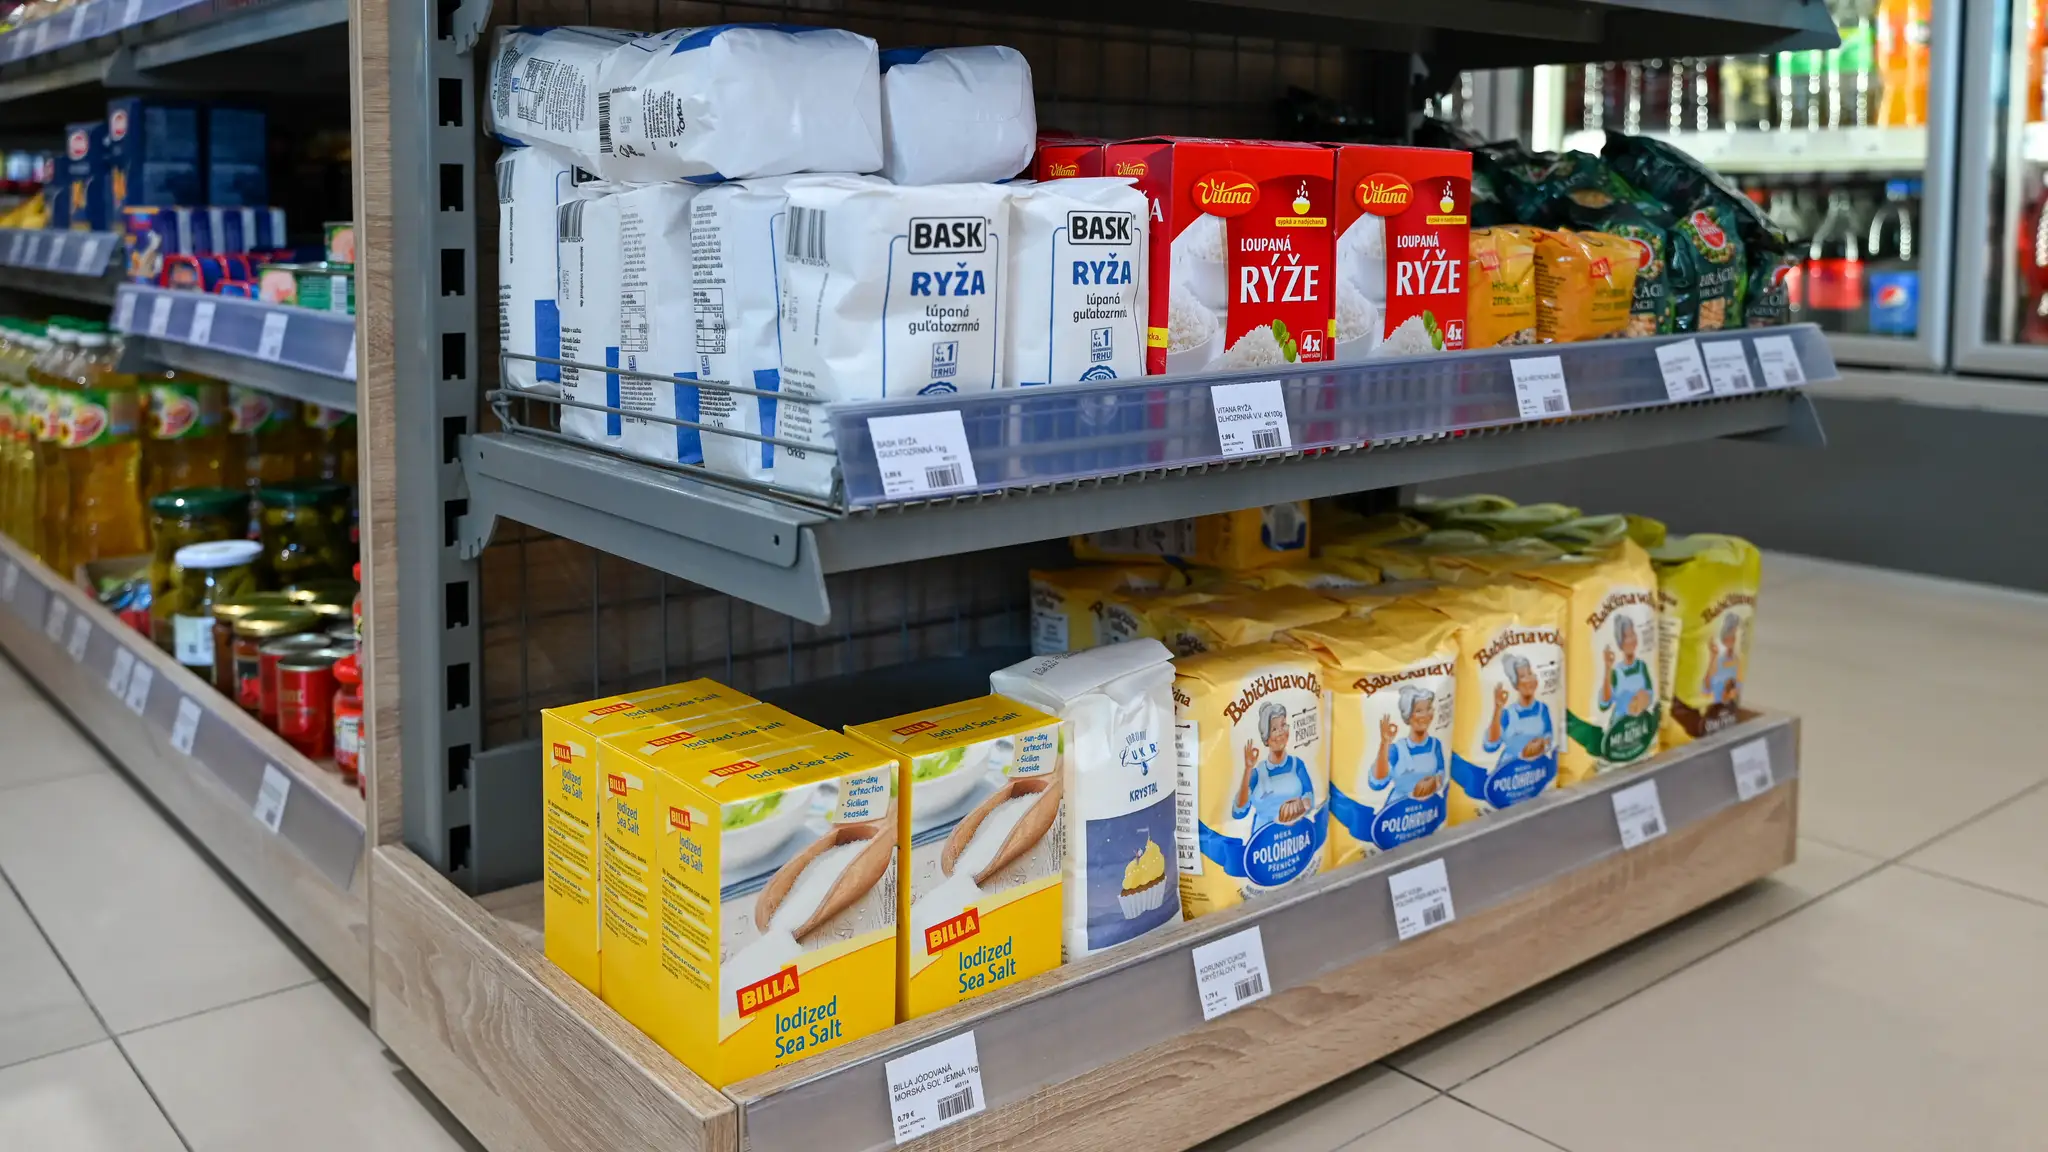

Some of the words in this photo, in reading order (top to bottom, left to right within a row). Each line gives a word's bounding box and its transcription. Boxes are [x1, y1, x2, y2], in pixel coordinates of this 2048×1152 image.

[1049, 162, 1080, 177] Vitana
[1116, 160, 1148, 176] Vitana
[1197, 178, 1257, 205] Vitana
[1359, 180, 1409, 205] Vitana
[914, 222, 983, 249] BASK
[1072, 216, 1130, 241] BASK
[1241, 235, 1292, 253] LOUPANÁ
[1397, 231, 1440, 248] LOUPANÁ
[1072, 252, 1132, 286] RYŽA
[1396, 248, 1461, 296] RÝŽE
[910, 262, 986, 297] RYŽA
[1240, 253, 1320, 304] RÝŽE
[1086, 292, 1121, 308] lúpaná
[925, 304, 970, 321] lúpaná
[908, 317, 980, 335] guľatozrnná
[1447, 324, 1462, 341] 4x
[1093, 331, 1101, 340] Č.
[1103, 329, 1109, 346] 1
[1302, 335, 1321, 352] 4x
[947, 344, 954, 361] 1
[1092, 351, 1111, 361] TRHU
[933, 367, 955, 377] TRHU
[1216, 405, 1237, 414] VITANA
[1237, 403, 1252, 412] RYŽA
[1218, 412, 1253, 423] DLHOZRNNÁ
[1264, 410, 1283, 418] 4X100g
[897, 436, 918, 446] RYŽA
[623, 702, 670, 718] Iodized
[670, 698, 694, 709] Sea
[694, 692, 721, 704] Salt
[1223, 673, 1291, 727] Babičkina
[598, 703, 633, 716] BILLA
[684, 731, 732, 749] Iodized
[732, 727, 756, 737] Sea
[756, 720, 785, 732] Salt
[926, 723, 974, 740] Iodized
[972, 716, 994, 727] Sea
[994, 711, 1022, 722] Salt
[654, 733, 690, 746] BILLA
[1022, 741, 1053, 753] extraction
[1023, 733, 1048, 743] sun-dry
[554, 746, 571, 761] BILLA
[1020, 755, 1040, 764] Sicilian
[717, 761, 756, 777] BILLA
[746, 762, 799, 780] Iodized
[798, 758, 825, 769] Sea
[823, 751, 855, 761] Salt
[1018, 764, 1040, 773] seaside
[561, 765, 582, 787] Iodized
[851, 775, 879, 786] sun-dry
[561, 779, 572, 795] Sea
[571, 785, 584, 801] Salt
[609, 778, 626, 793] BILLA
[848, 784, 884, 797] extraction
[1129, 781, 1158, 803] KRYSTAL
[616, 798, 638, 821] Iodized
[846, 798, 869, 808] Sicilian
[671, 810, 690, 828] BILLA
[843, 809, 869, 819] seaside
[1381, 807, 1439, 833] POLOHRUBÁ
[616, 812, 627, 829] Sea
[627, 821, 640, 837] Salt
[679, 831, 702, 857] Iodized
[1252, 830, 1311, 865] POLOHRUBÁ
[679, 846, 690, 865] Sea
[691, 854, 704, 874] Salt
[928, 914, 977, 949] BILLA
[959, 935, 1013, 972] Iodized
[1227, 951, 1247, 964] CUKOR
[958, 967, 986, 994] Sea
[988, 958, 1017, 985] Salt
[741, 972, 797, 1012] BILLA
[775, 995, 838, 1036] Iodized
[775, 1031, 807, 1060] Sea
[808, 1019, 843, 1048] Salt
[893, 1078, 914, 1093] BILLA
[914, 1063, 953, 1085] JÓDOVANÁ
[894, 1084, 926, 1103] MORSKÁ
[927, 1079, 942, 1091] SOĽ
[942, 1068, 967, 1084] JEMNÁ
[967, 1065, 979, 1075] 1kg
[897, 1112, 909, 1123] 0,79
